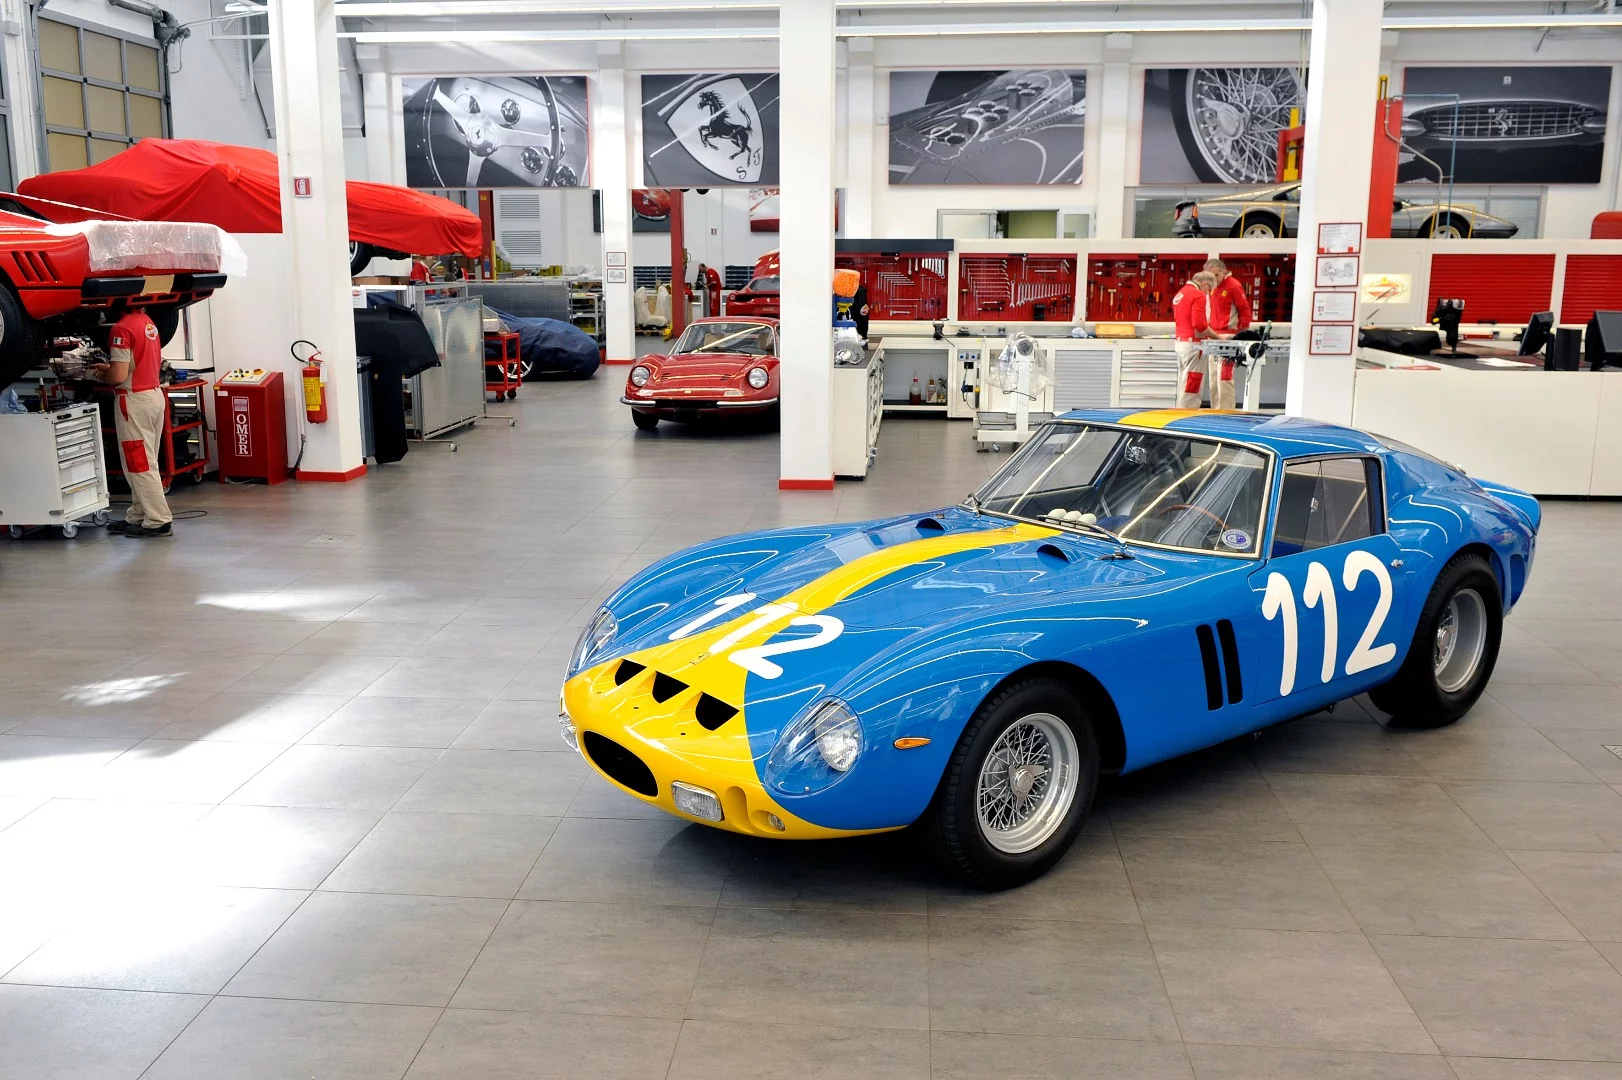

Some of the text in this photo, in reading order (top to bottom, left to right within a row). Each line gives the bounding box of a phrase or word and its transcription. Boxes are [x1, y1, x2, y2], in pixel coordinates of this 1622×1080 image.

[736, 165, 747, 180] S
[236, 413, 249, 455] OMER
[668, 592, 845, 680] 112
[1262, 550, 1397, 697] 112
